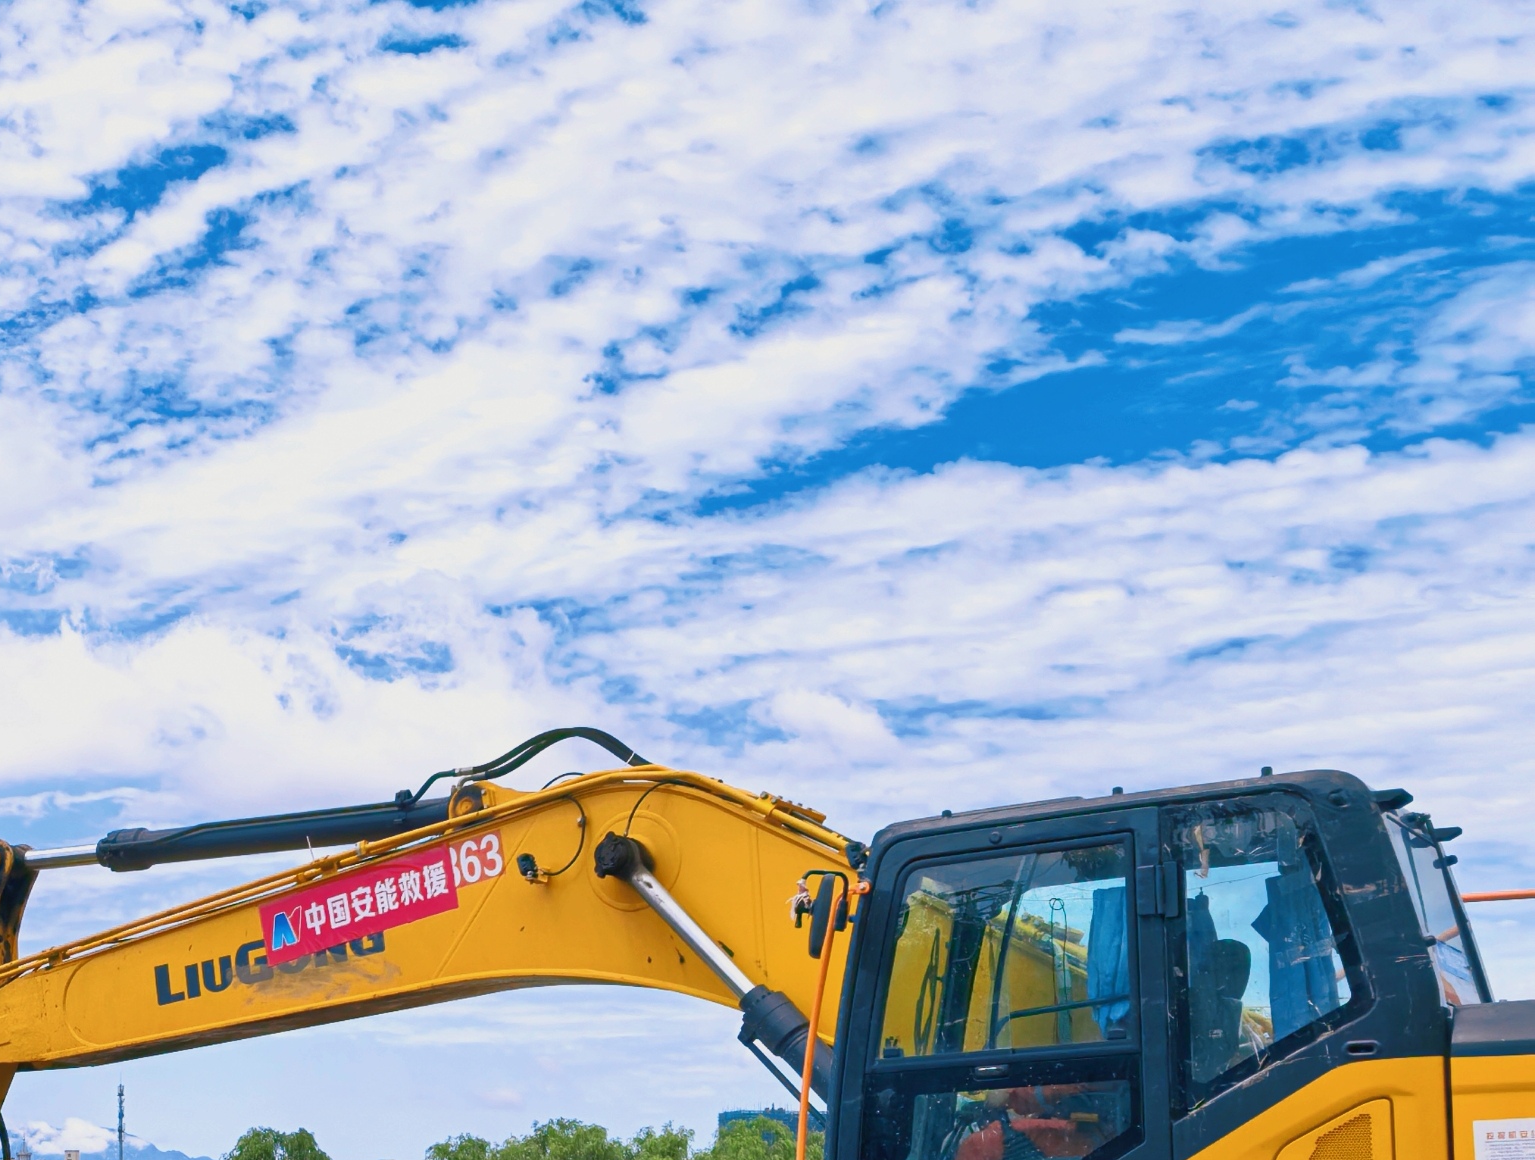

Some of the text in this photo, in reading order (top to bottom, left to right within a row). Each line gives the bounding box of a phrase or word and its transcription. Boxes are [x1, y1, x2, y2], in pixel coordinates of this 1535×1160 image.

[304, 859, 449, 936] 中国安能救援
